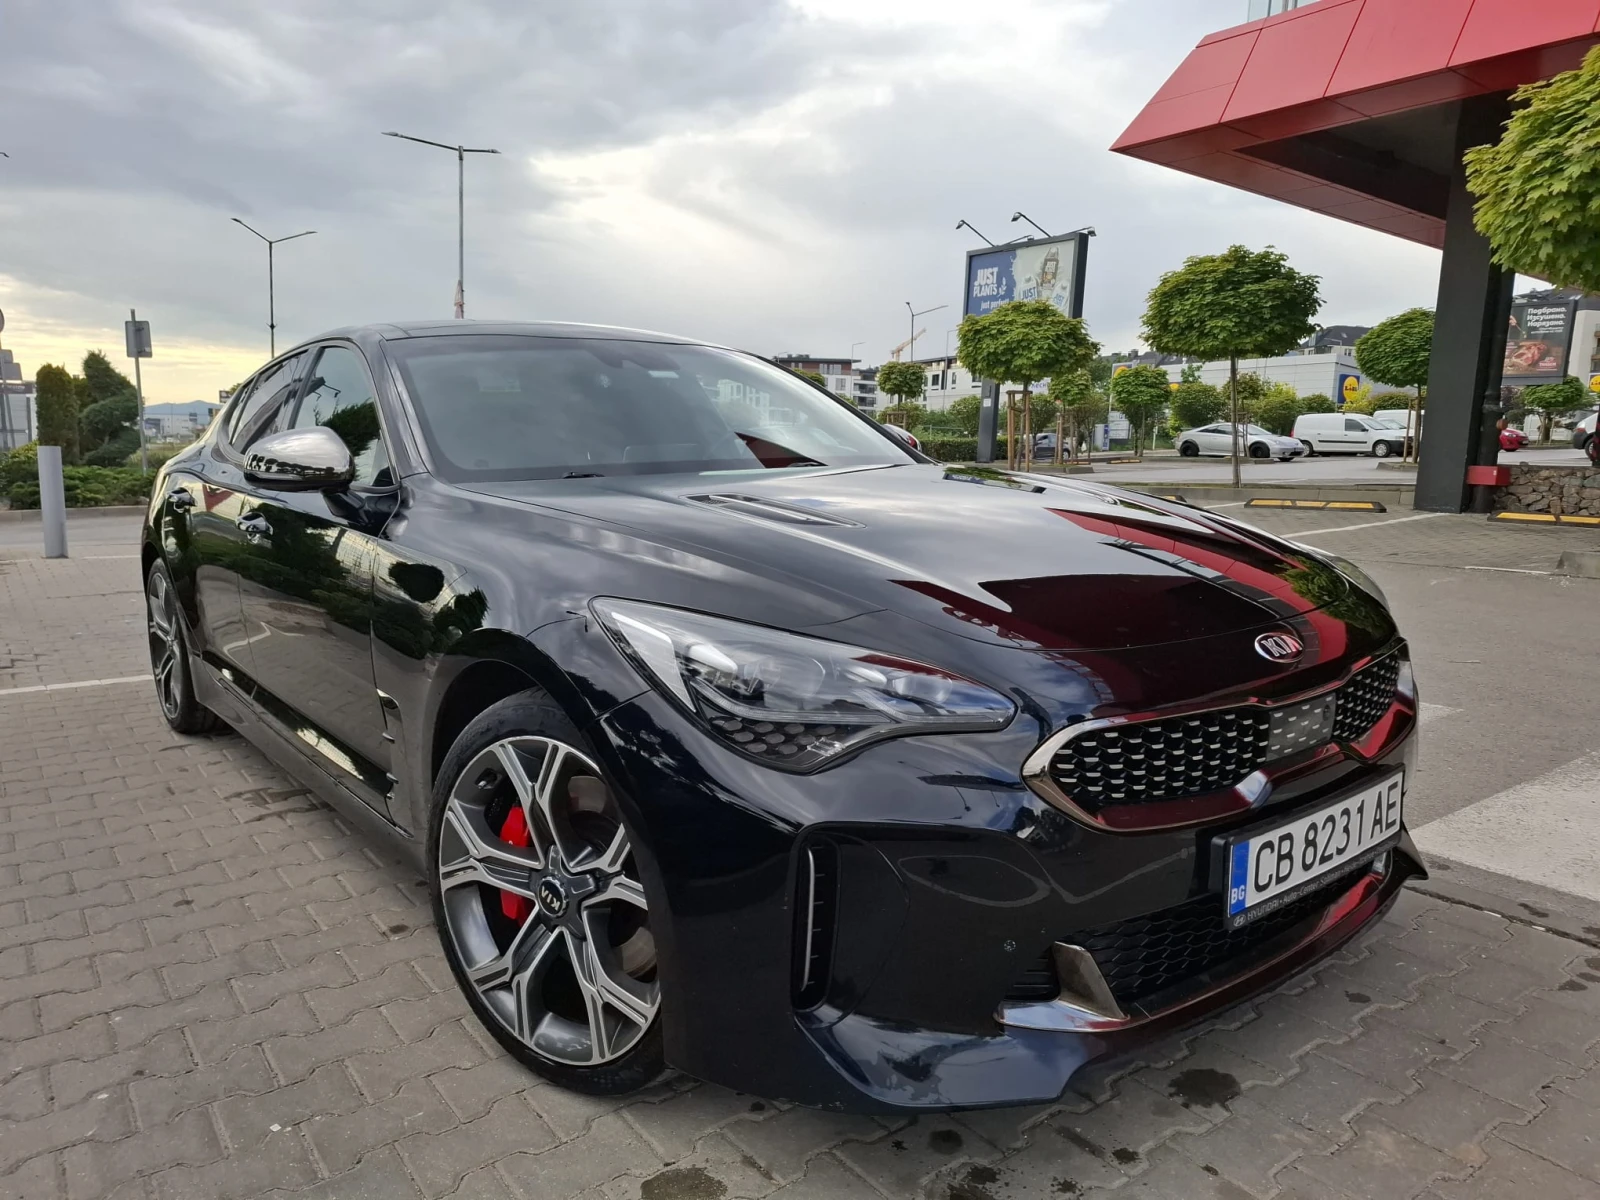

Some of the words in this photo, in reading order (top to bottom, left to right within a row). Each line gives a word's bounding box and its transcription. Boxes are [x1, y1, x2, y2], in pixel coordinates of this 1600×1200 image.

[974, 267, 998, 285] JUST
[973, 284, 997, 297] PLANTS
[1022, 287, 1036, 300] JUST
[980, 301, 989, 311] just
[1260, 635, 1303, 657] KIA
[1254, 832, 1295, 893] CB
[1301, 799, 1365, 872] 8231
[1370, 781, 1399, 840] AE
[541, 885, 561, 911] KIA
[1231, 884, 1246, 904] BG
[1247, 898, 1280, 921] HYUNDAI
